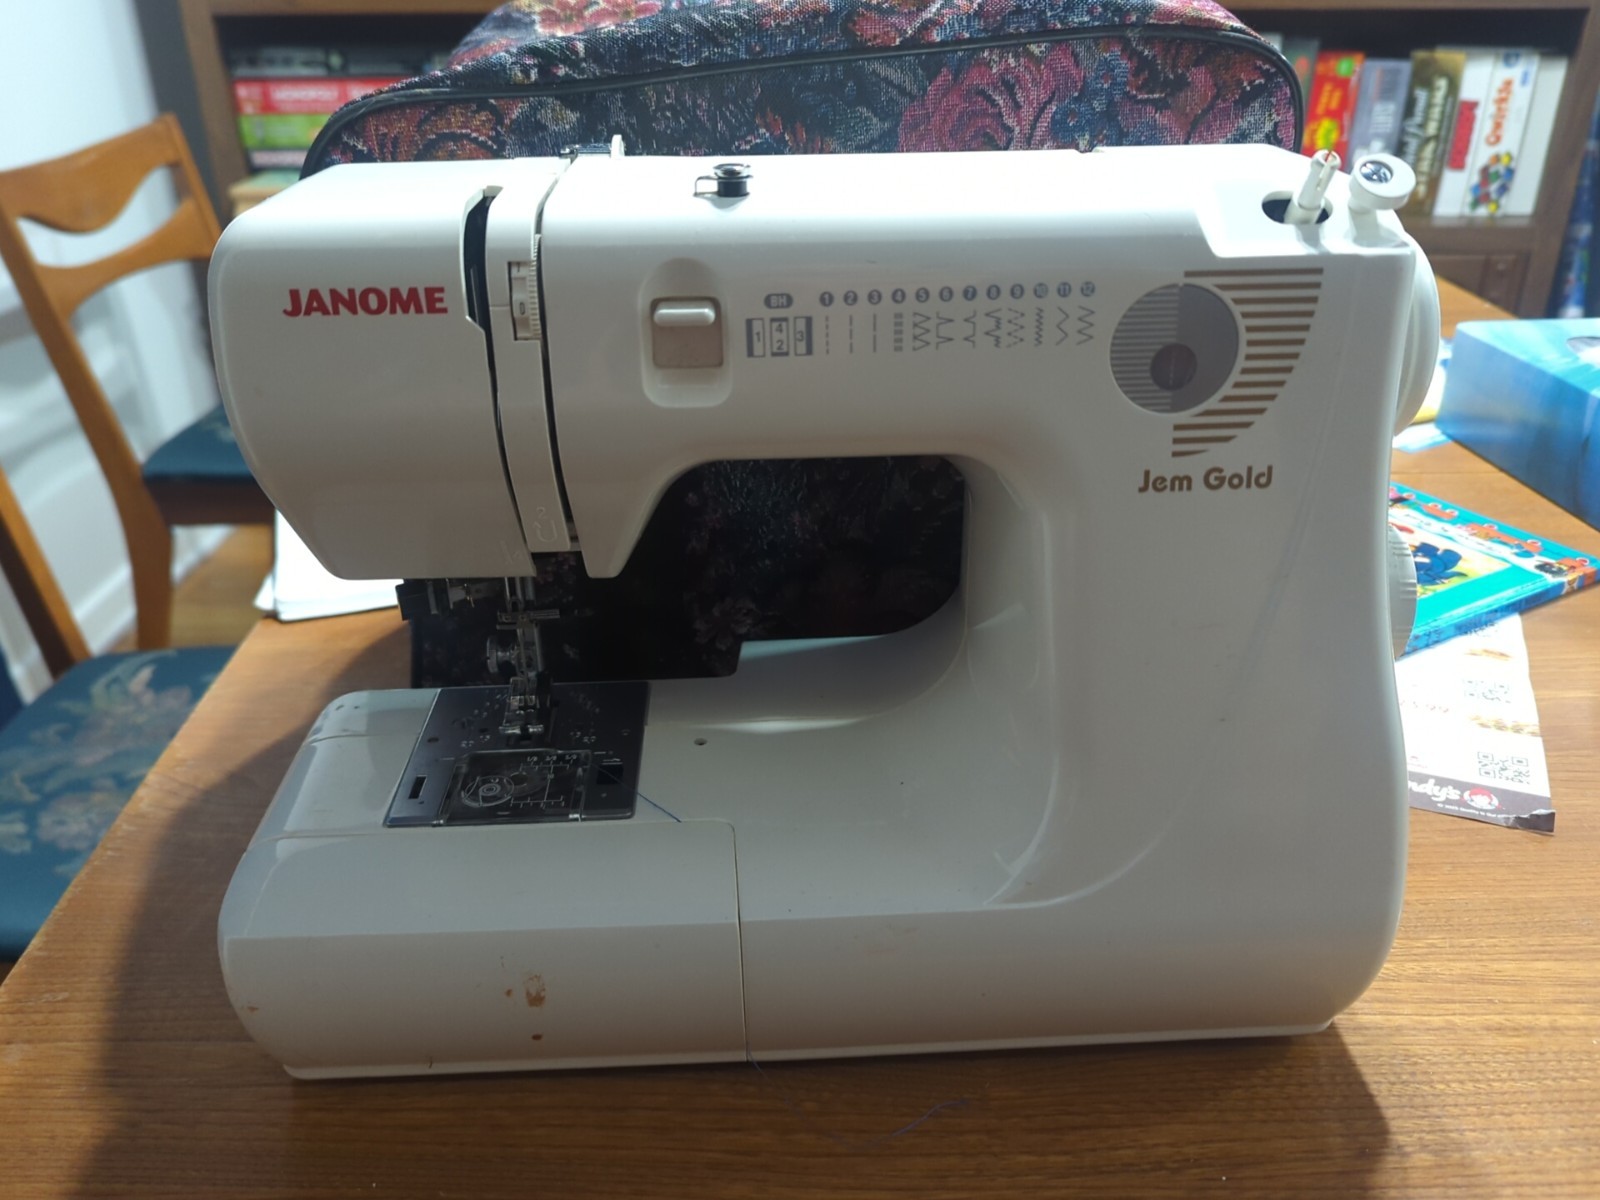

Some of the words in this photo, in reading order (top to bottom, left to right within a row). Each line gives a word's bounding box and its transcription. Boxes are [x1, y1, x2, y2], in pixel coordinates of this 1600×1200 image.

[282, 286, 448, 317] JANOME
[768, 294, 789, 307] BH
[775, 322, 784, 334] 4
[755, 330, 762, 343] 1
[796, 330, 804, 342] 3
[776, 339, 785, 351] 2
[1138, 469, 1193, 493] Jem
[1203, 465, 1273, 491] Gold
[1408, 779, 1461, 802] ndy's
